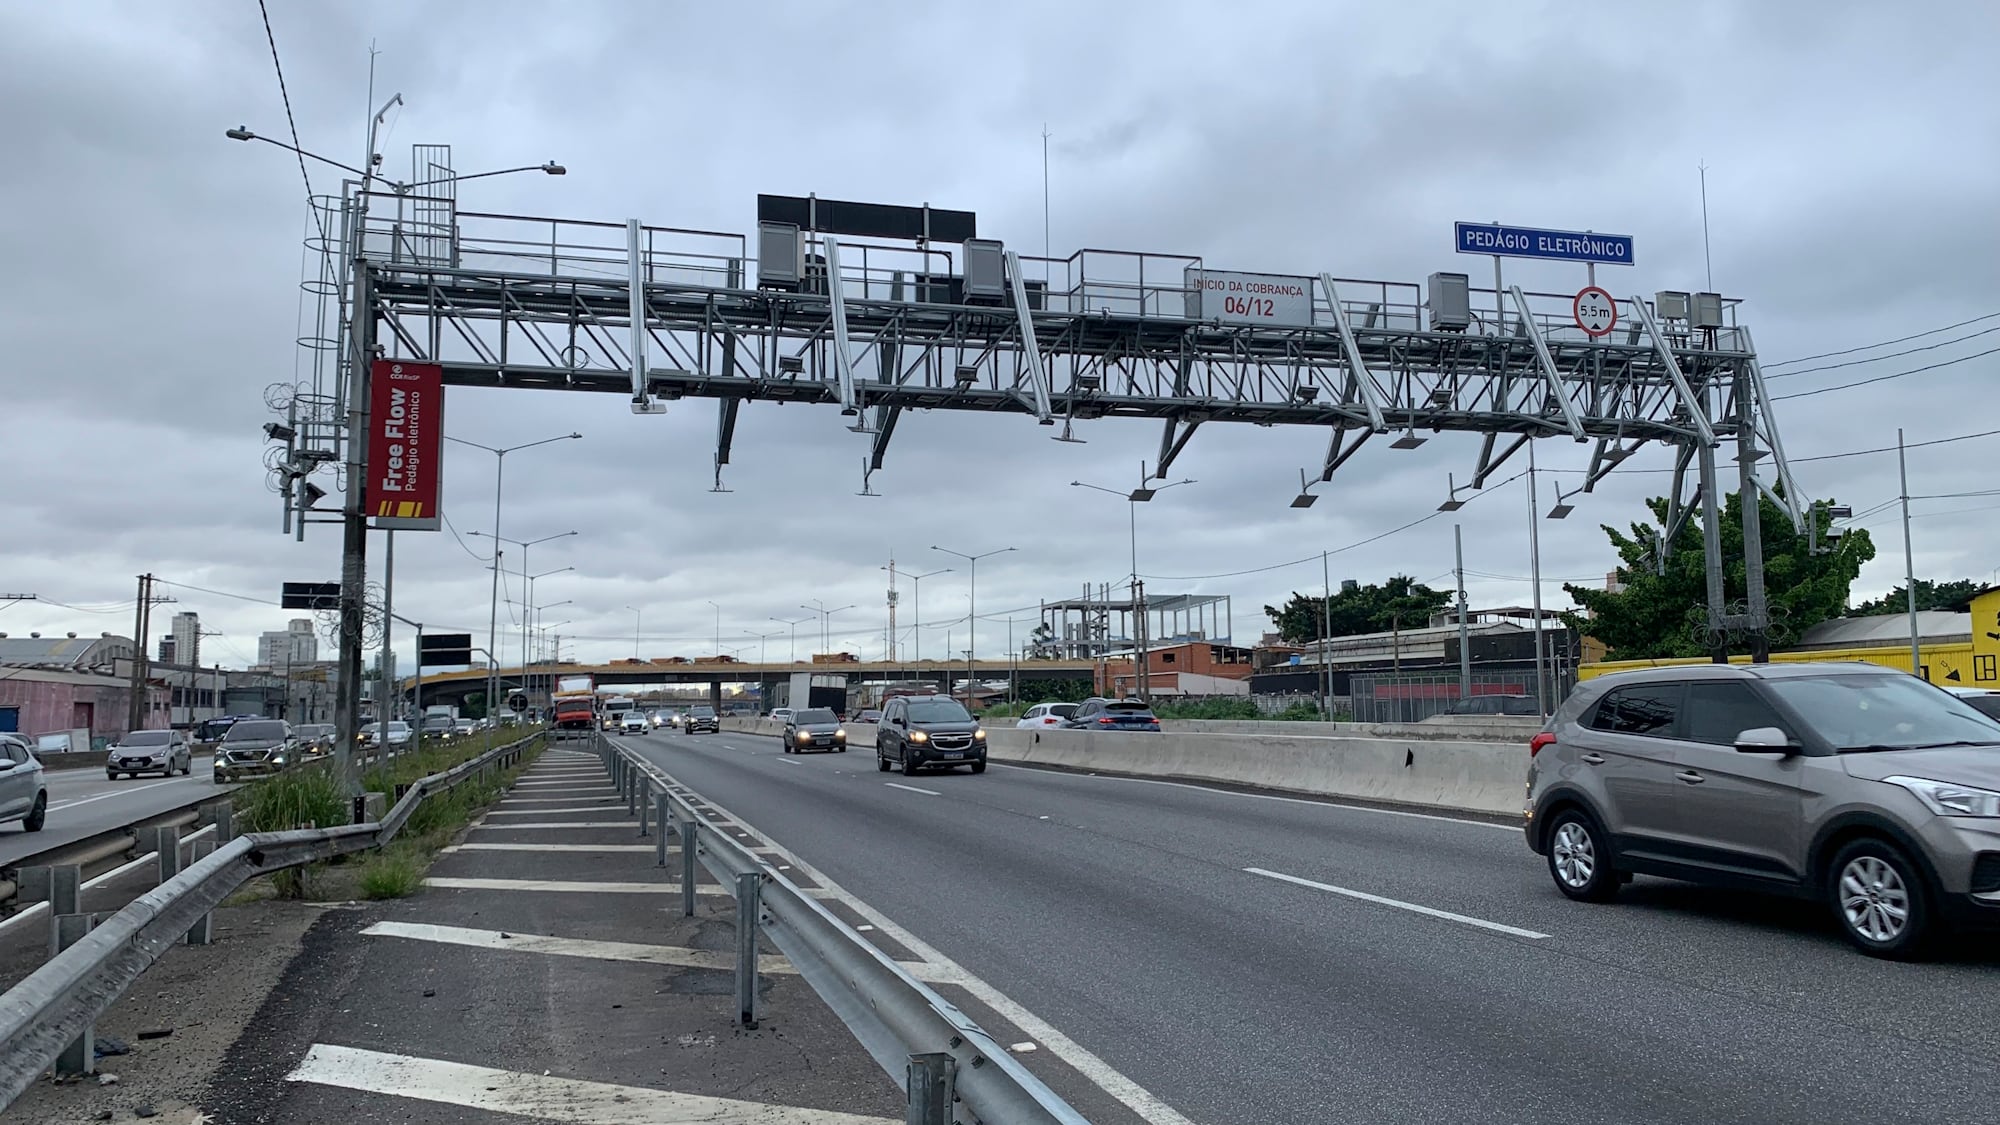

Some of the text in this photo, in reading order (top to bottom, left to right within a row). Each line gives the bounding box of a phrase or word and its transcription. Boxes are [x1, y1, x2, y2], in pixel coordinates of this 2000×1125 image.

[1466, 229, 1624, 257] PEDÁGIO ELETRÔNICO
[1193, 276, 1304, 298] INÍCIO DA COBRANÇA
[1225, 296, 1274, 317] 06/12
[383, 388, 406, 491] Free Flow
[405, 391, 420, 491] Pedágio eletrônico
